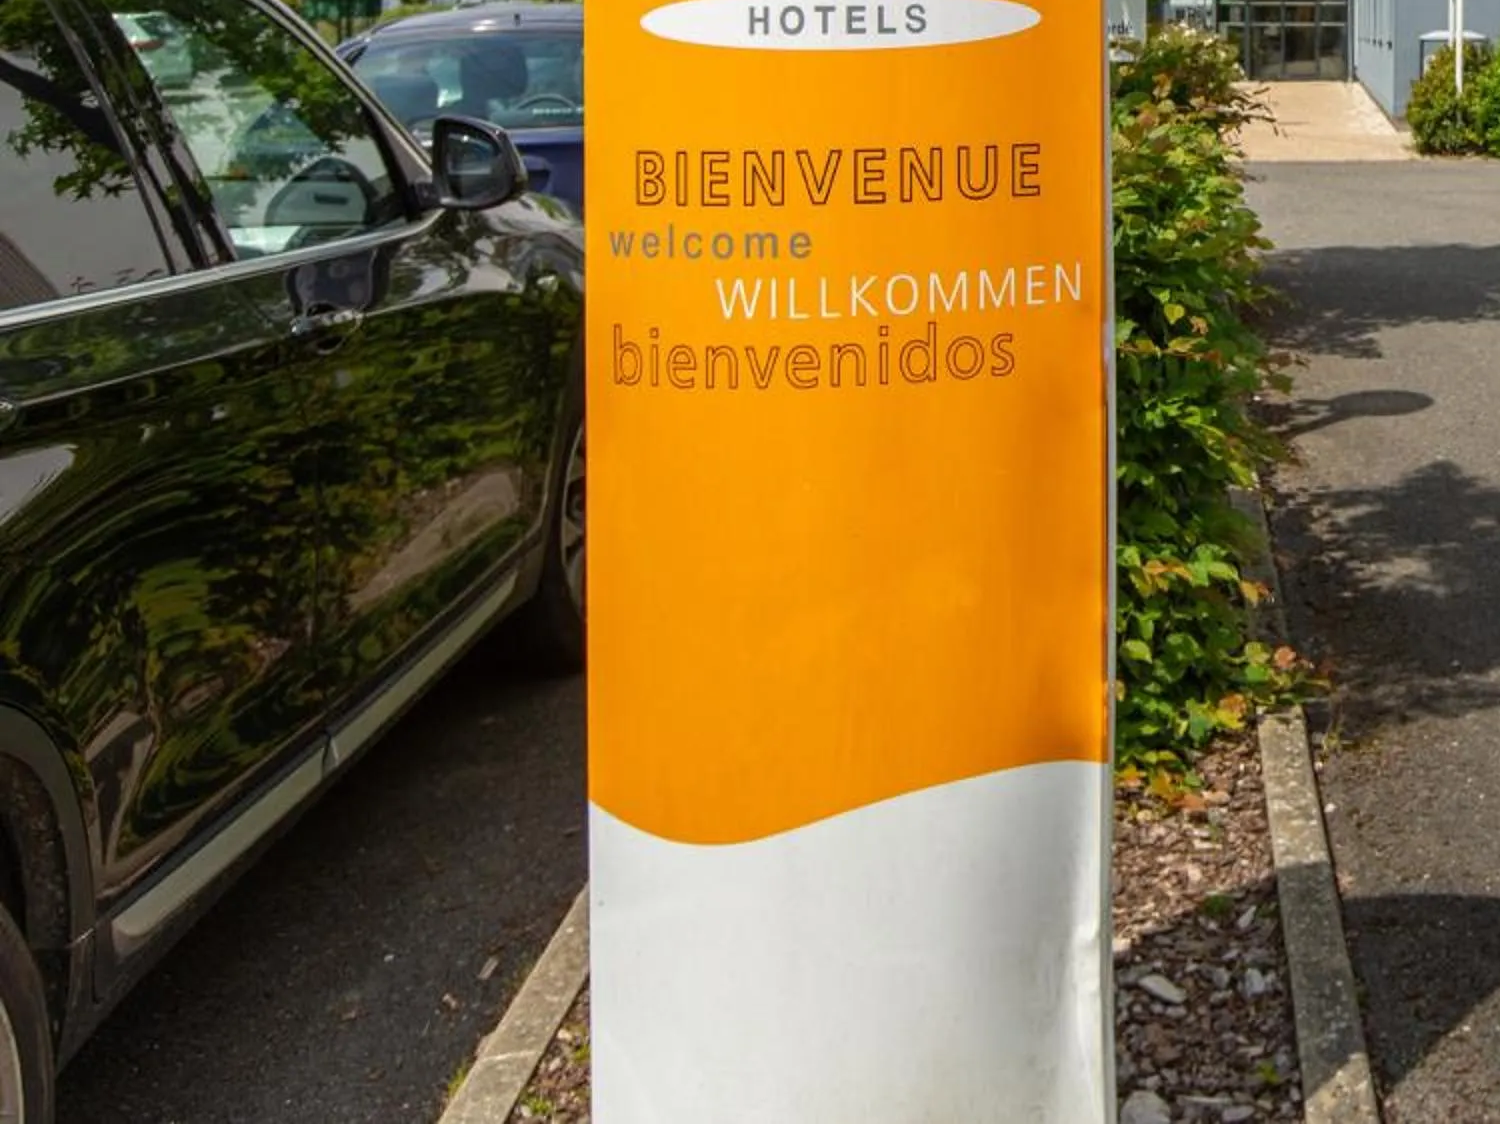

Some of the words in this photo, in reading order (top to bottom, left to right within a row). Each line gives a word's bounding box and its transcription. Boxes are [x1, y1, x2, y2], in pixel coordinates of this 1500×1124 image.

[748, 4, 928, 36] HOTELS
[635, 143, 1041, 207] BIENVENUE
[610, 224, 813, 260] welcome
[716, 262, 1082, 320] WILLKOMMEN
[612, 322, 1016, 390] bienvenidos
